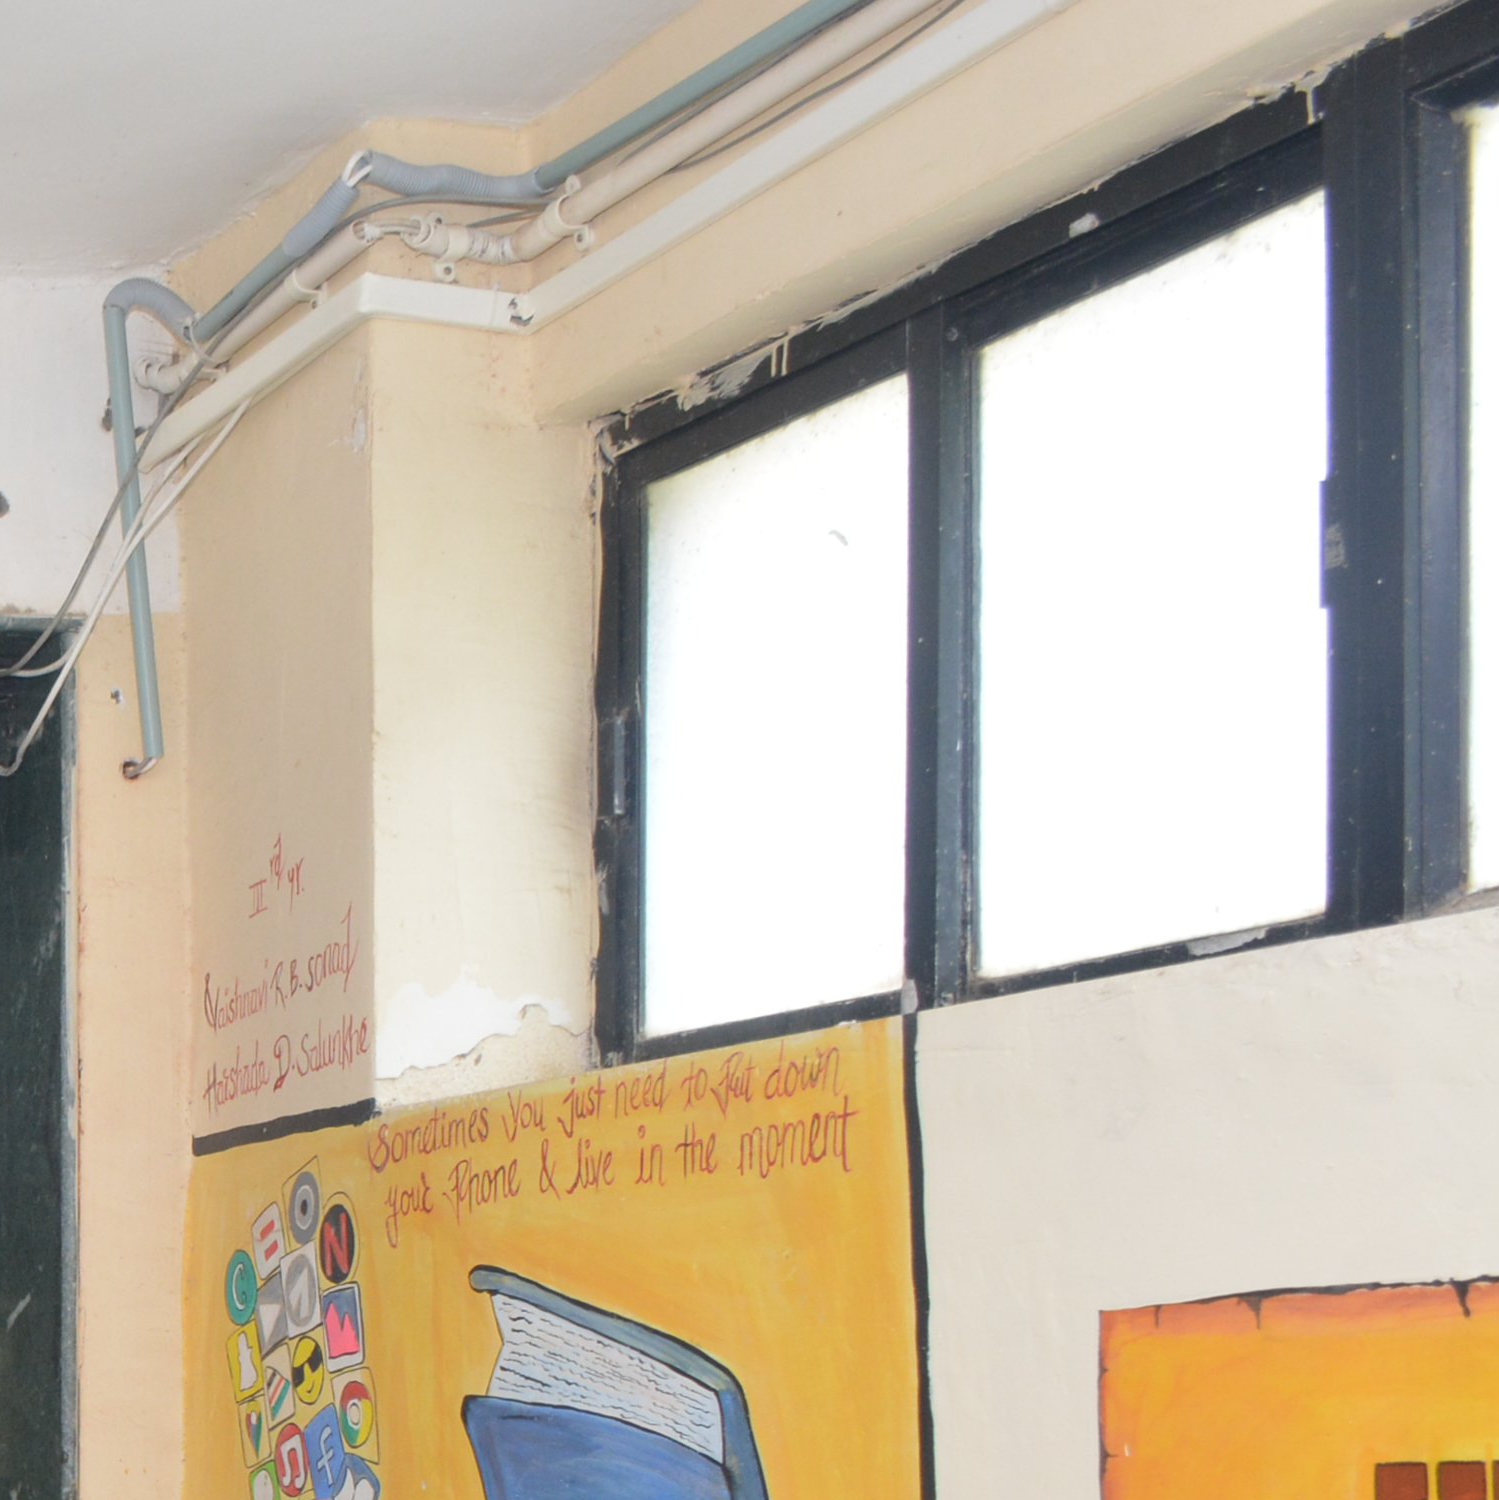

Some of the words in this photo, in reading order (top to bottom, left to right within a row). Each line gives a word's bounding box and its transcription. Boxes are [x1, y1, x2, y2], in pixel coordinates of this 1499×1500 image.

[368, 1106, 490, 1176] Sometimes
[557, 1076, 607, 1139] just
[614, 1058, 671, 1120] need
[681, 1060, 708, 1112] to
[764, 1038, 845, 1101] down
[539, 1138, 562, 1200] &
[566, 1138, 615, 1194] live
[635, 1124, 667, 1187] in
[674, 1122, 718, 1179] the
[737, 1094, 860, 1179] moment
[323, 1211, 350, 1278] N
